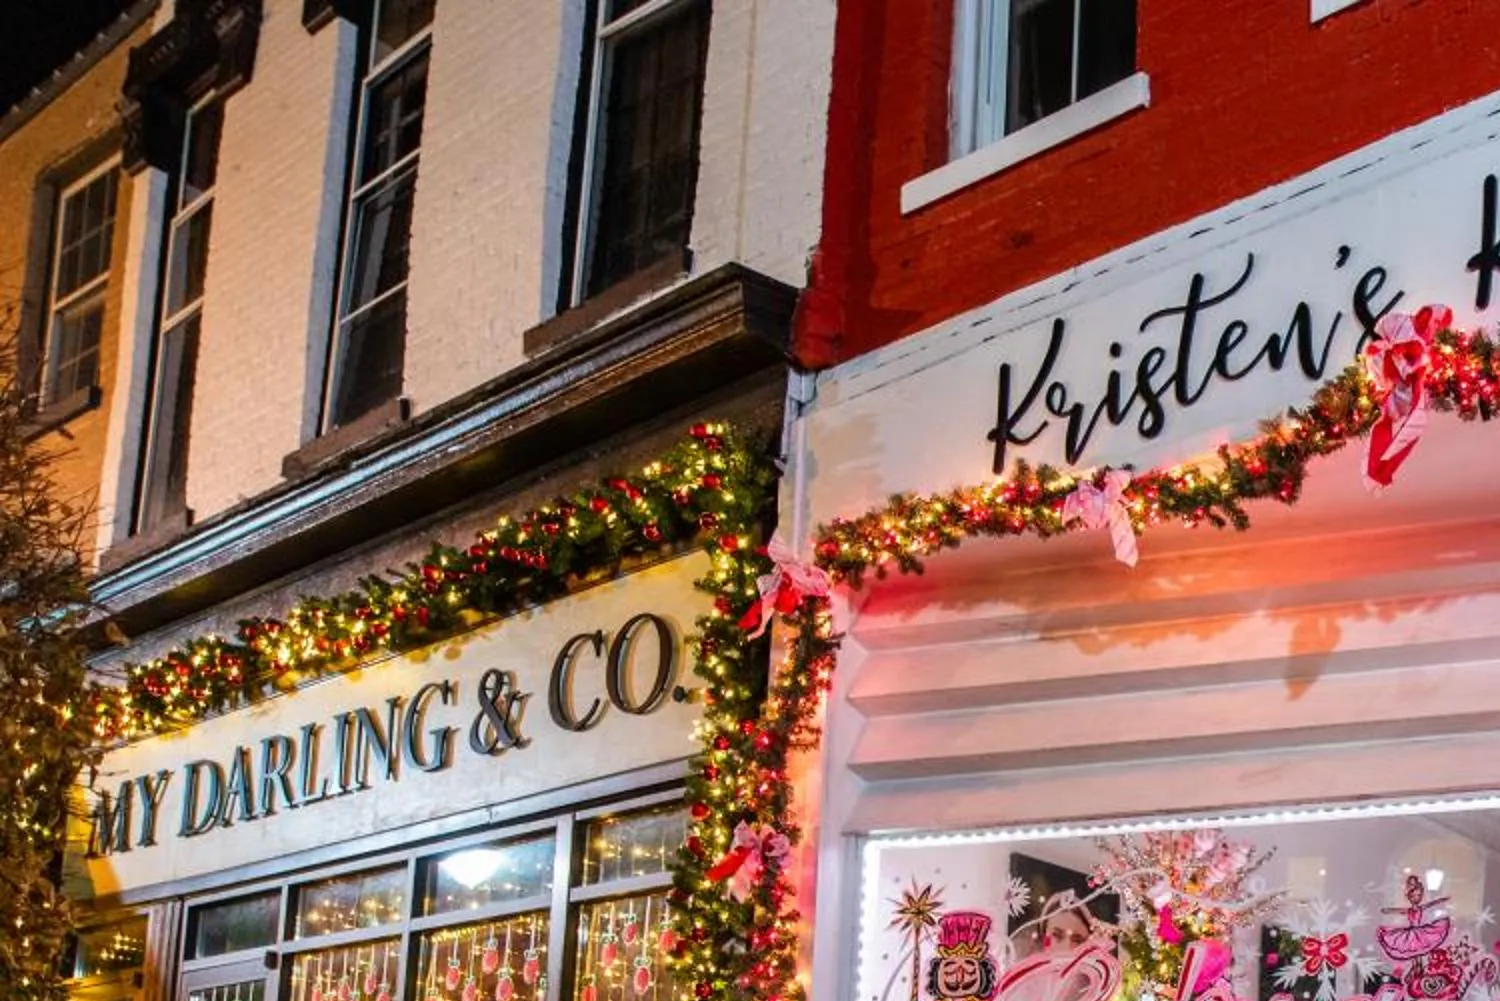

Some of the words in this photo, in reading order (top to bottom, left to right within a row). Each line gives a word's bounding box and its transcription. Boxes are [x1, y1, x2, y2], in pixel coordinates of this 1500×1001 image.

[987, 245, 1404, 475] Kristen's
[85, 768, 174, 858] MY
[177, 679, 452, 838] DARLING
[470, 668, 528, 756] &
[549, 613, 688, 732] CO.
